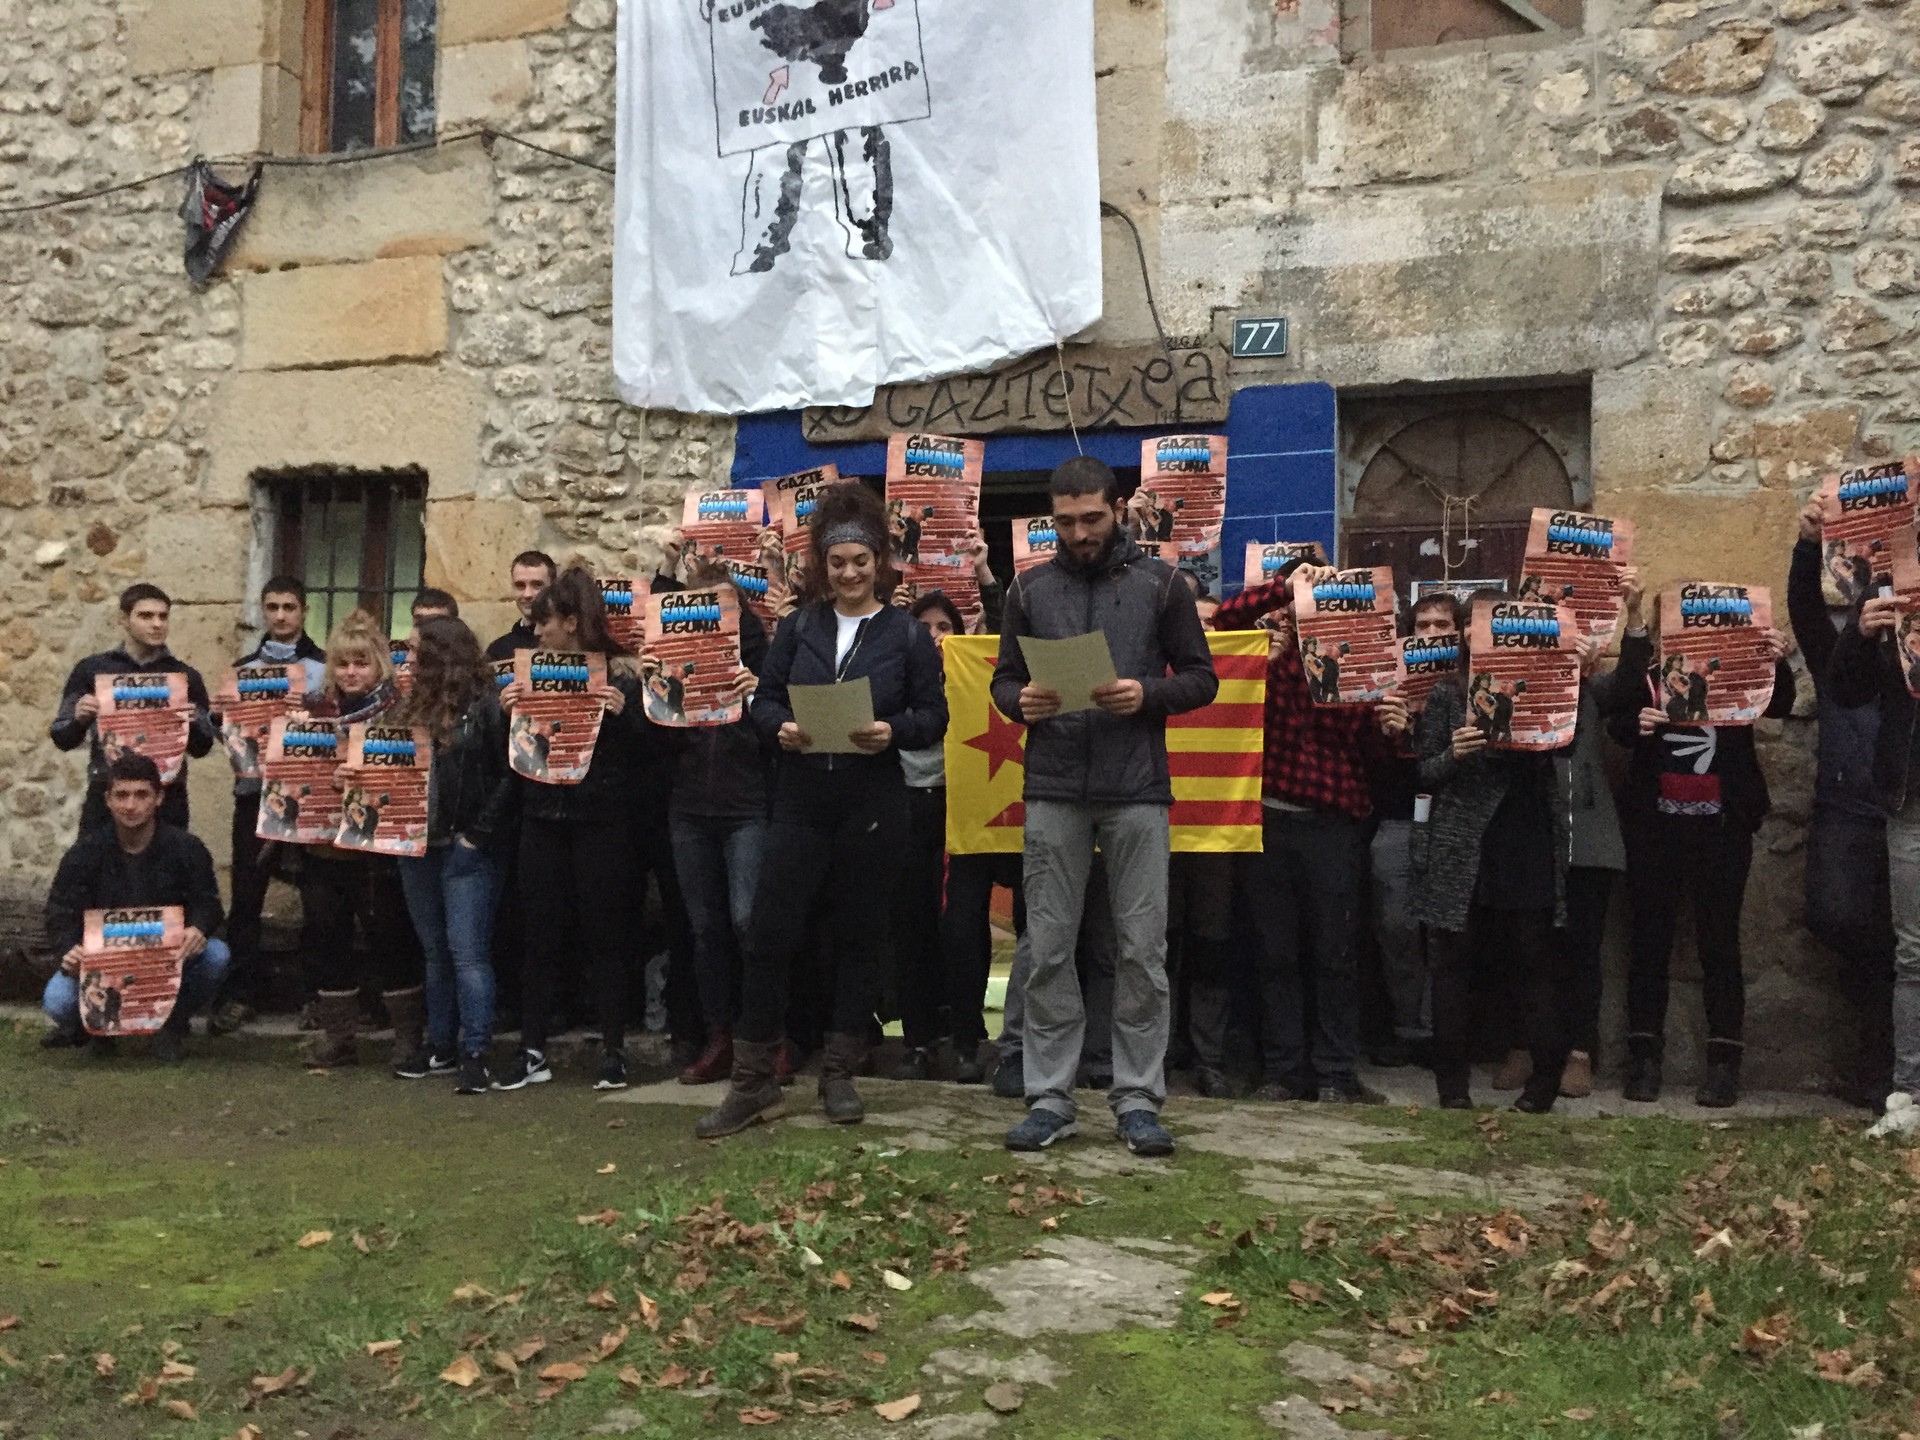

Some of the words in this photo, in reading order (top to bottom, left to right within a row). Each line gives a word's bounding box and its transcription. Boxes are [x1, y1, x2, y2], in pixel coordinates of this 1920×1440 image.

[739, 98, 816, 127] EUSKAL
[828, 60, 919, 106] HERRIRA
[1241, 322, 1280, 351] 77
[906, 434, 965, 451] GAZTE
[1157, 437, 1210, 450] GAZTE
[905, 449, 965, 470] SAKANA
[776, 470, 825, 490] GAZTE
[1840, 462, 1906, 485] GAZTE
[700, 491, 747, 502] GAZTE
[1838, 475, 1908, 501] SAKANA
[1550, 512, 1614, 532] GAZTE
[1547, 525, 1613, 548] SAKANA
[661, 592, 719, 608] GAZTE
[1312, 583, 1376, 600] SAKANA
[1681, 584, 1748, 599] GAZTE
[660, 605, 721, 622] SAKANA
[1316, 598, 1376, 612] EGUNA
[1492, 603, 1557, 619] GAZTE
[1681, 598, 1753, 615] SAKANA
[662, 620, 720, 634] EGUNA
[1491, 618, 1560, 636] SAKANA
[1403, 634, 1459, 650] GAZTE
[1493, 634, 1560, 648] EGUNA
[530, 651, 587, 666] GAZTE
[530, 664, 590, 682] SAKANA
